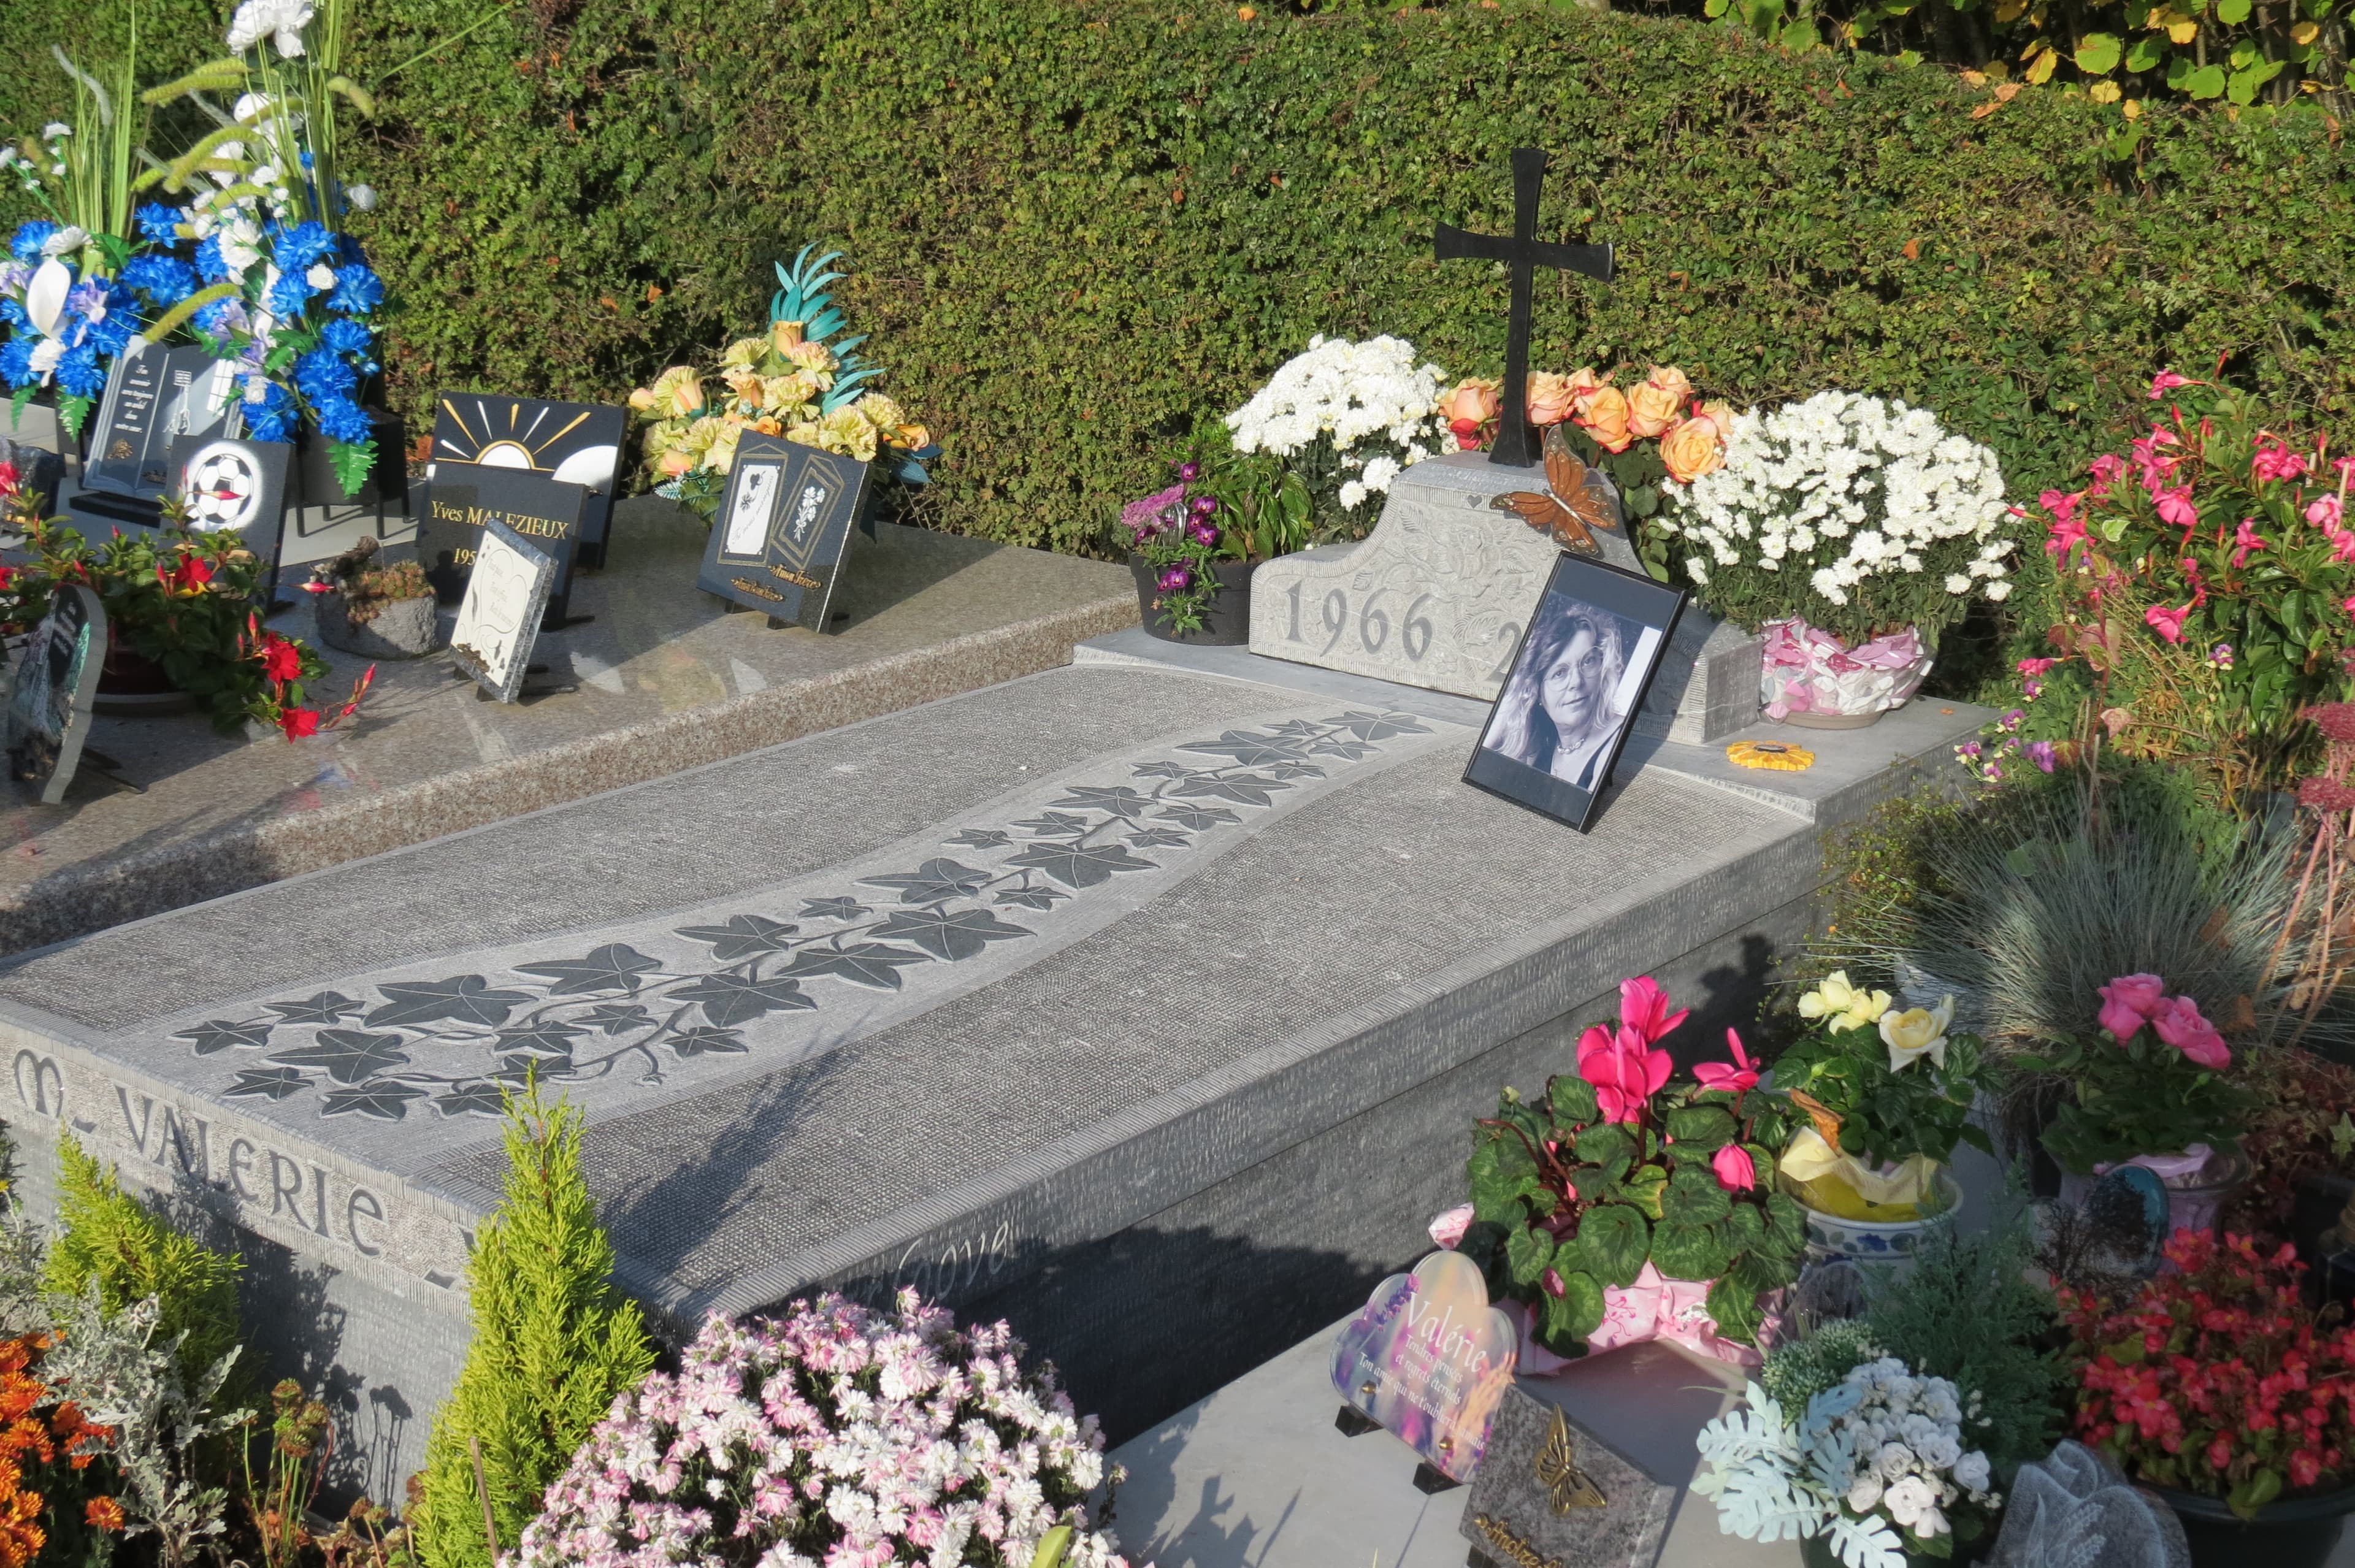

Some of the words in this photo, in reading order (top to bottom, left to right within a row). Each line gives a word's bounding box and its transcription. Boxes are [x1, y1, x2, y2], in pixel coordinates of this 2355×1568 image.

[431, 500, 463, 523] Yves
[453, 548, 478, 566] 195
[1284, 580, 1436, 662] 1966
[1407, 1291, 1487, 1373] Valérie
[1395, 1354, 1403, 1365] et
[1404, 1360, 1431, 1383] regrets
[1430, 1375, 1461, 1405] éternels
[1406, 1334, 1434, 1363] Tendres
[1433, 1358, 1463, 1383] pensées
[1360, 1352, 1374, 1372] Ton
[1393, 1379, 1407, 1396] qui
[1408, 1390, 1417, 1404] ne
[1457, 1426, 1485, 1451] amais
